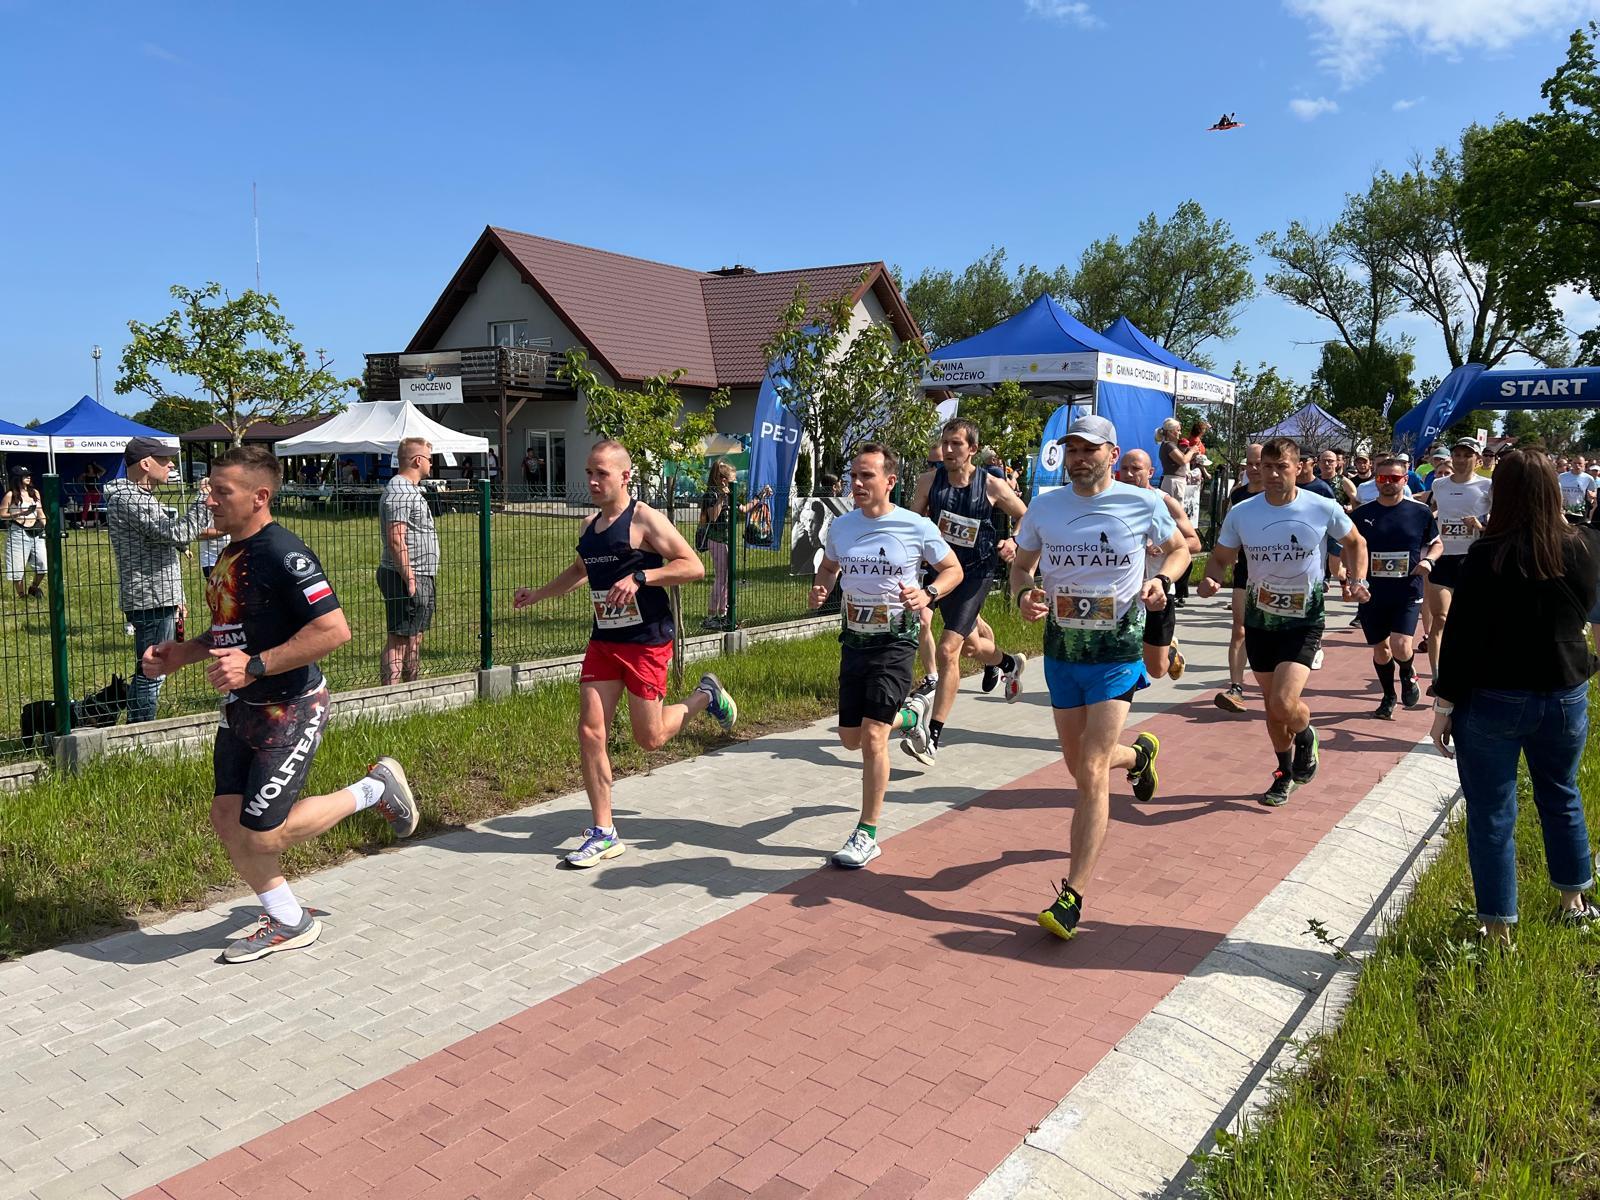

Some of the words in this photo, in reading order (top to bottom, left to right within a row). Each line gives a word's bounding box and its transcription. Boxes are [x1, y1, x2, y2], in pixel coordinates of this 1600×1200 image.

[1116, 365, 1134, 377] GMINA
[1135, 368, 1161, 383] CHOCZEWO
[410, 382, 452, 392] CHOCZEWO
[1500, 379, 1588, 397] START
[761, 422, 798, 445] PEJ
[944, 522, 970, 539] 116
[1445, 525, 1468, 535] 248
[1049, 554, 1131, 567] WATAHA
[1385, 559, 1394, 571] 6
[1078, 598, 1091, 618] 9
[1270, 594, 1292, 609] 23
[853, 606, 875, 622] 77
[244, 705, 325, 817] WOLFTEAM
